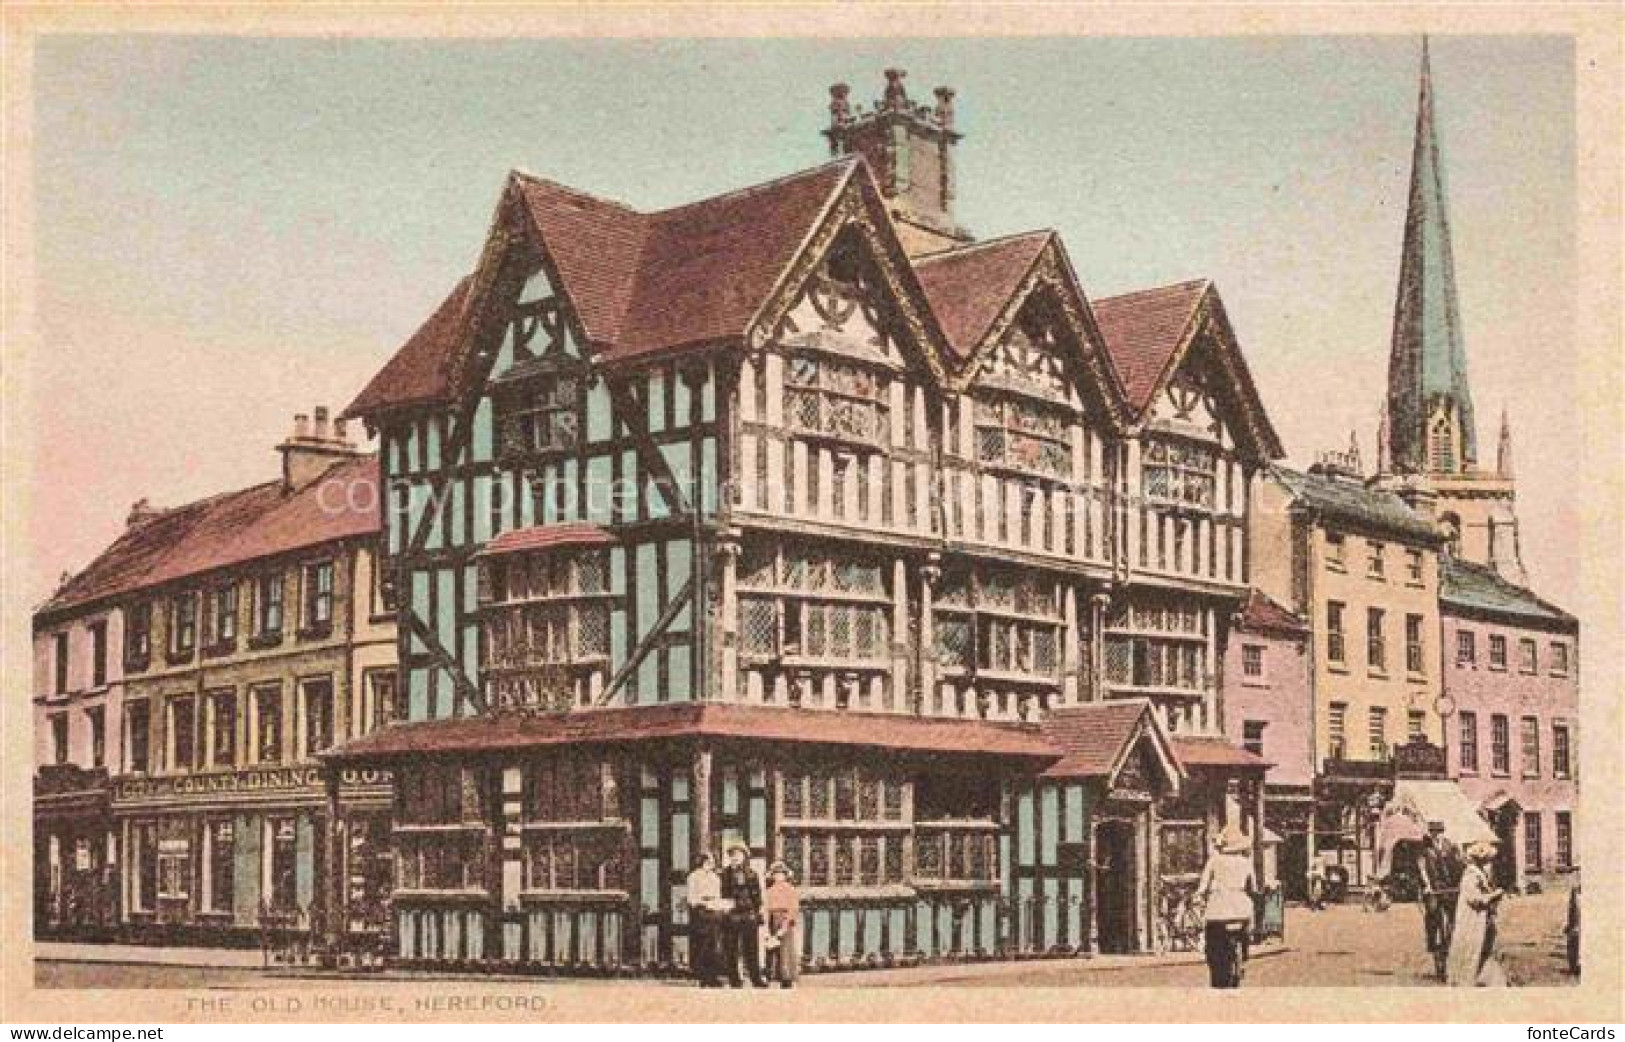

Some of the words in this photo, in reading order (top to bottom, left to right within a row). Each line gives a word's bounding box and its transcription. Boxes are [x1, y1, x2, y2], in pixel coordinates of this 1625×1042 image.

[246, 768, 319, 789] DINING
[187, 997, 232, 1012] THE
[252, 997, 301, 1012] OLD
